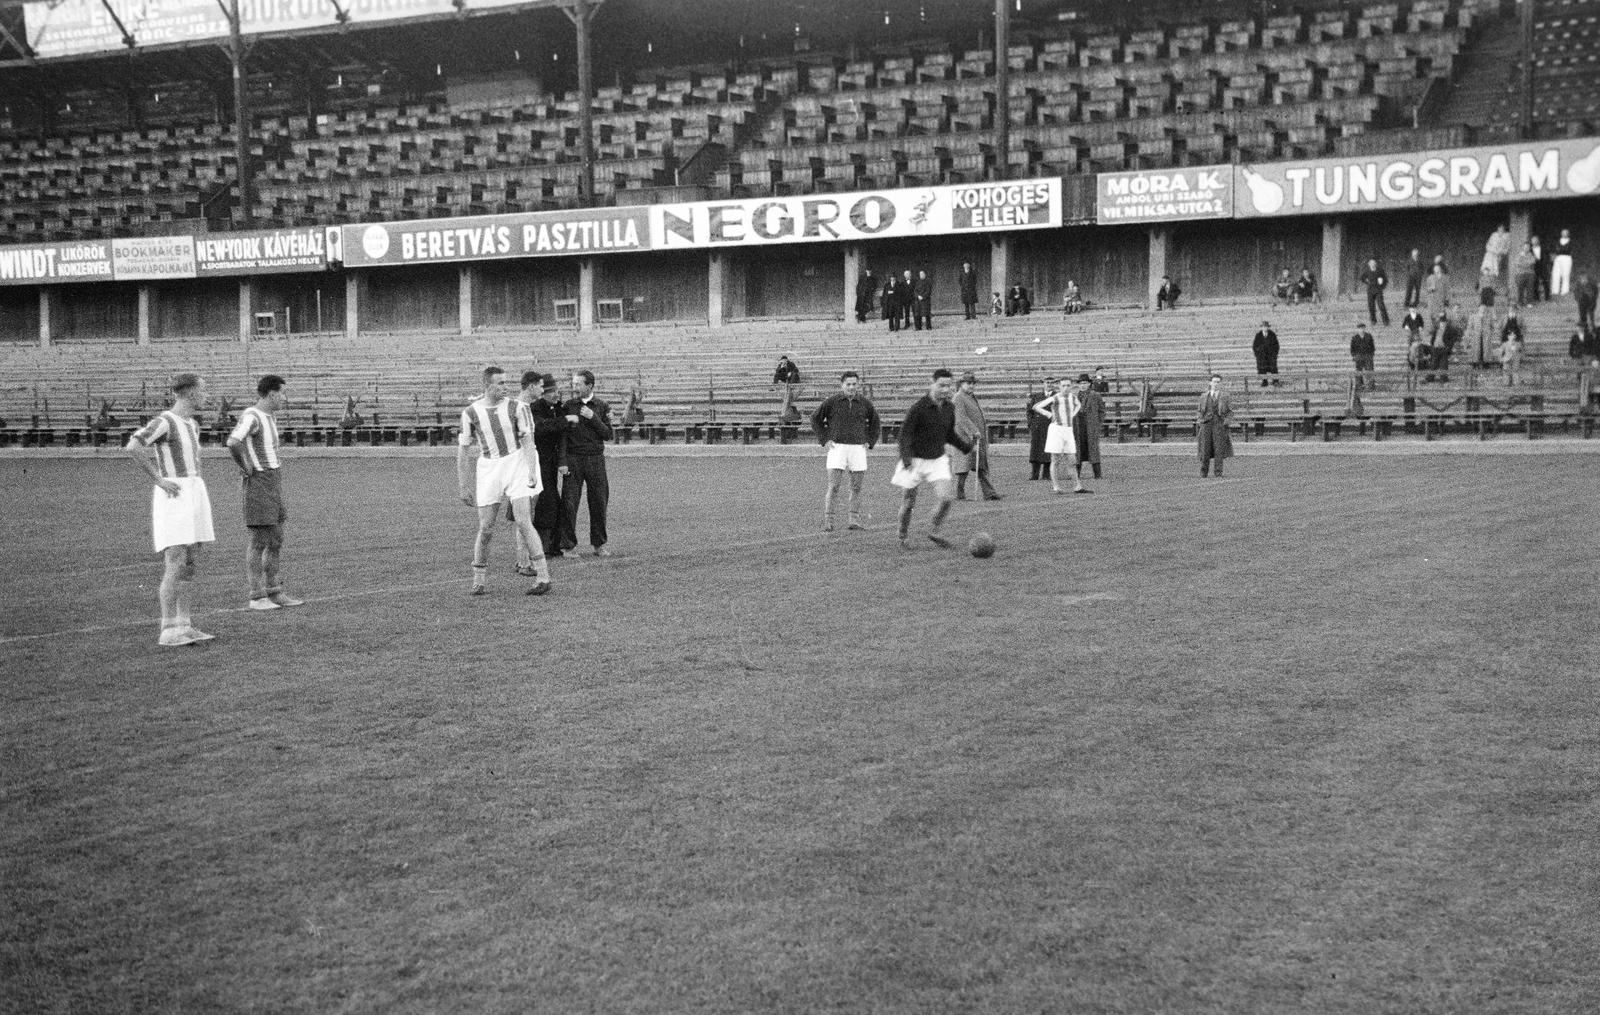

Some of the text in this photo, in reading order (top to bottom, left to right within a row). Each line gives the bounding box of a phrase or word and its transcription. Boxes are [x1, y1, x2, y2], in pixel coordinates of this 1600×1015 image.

[1107, 172, 1189, 196] MÓRA
[1286, 150, 1559, 207] TUNGSRAM
[662, 195, 897, 245] NEGRO
[971, 205, 1029, 227] ELLEN
[264, 228, 324, 257] KÁVÉHÁZ
[523, 218, 640, 252] PASZTILLA
[0, 249, 57, 280] WINDT
[114, 245, 191, 259] BOOKMAKER
[57, 261, 112, 277] KONZERVEK
